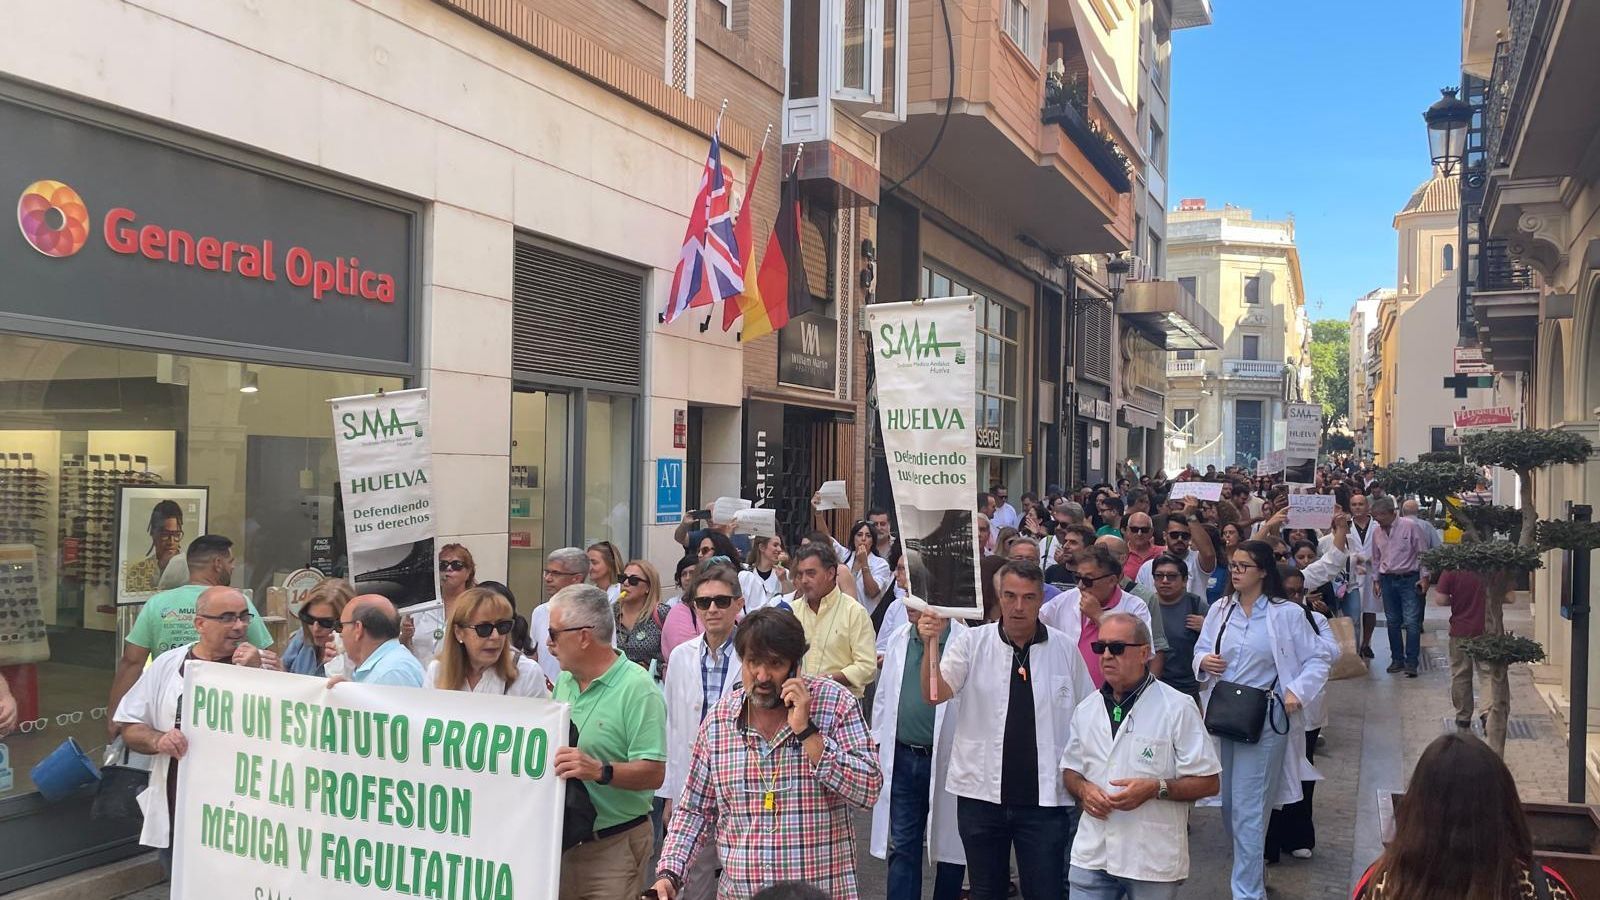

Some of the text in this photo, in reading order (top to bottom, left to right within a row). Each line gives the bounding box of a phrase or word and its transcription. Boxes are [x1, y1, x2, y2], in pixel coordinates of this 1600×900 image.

[103, 207, 395, 303] General Optica
[880, 317, 961, 361] SMA
[342, 408, 418, 440] SMA
[887, 408, 965, 430] HUELVA
[894, 451, 967, 466] Defendiendo
[351, 468, 428, 494] HUELVA
[661, 462, 680, 489] AT
[897, 469, 912, 481] tus
[353, 499, 430, 519] Defendiendo
[354, 513, 430, 534] tus derechos
[192, 685, 549, 780] POR UN ESTATUTO PROPIO
[234, 751, 473, 838] DE LA PROFESION
[201, 801, 514, 900] MÉDICA Y FACULTATIVA
